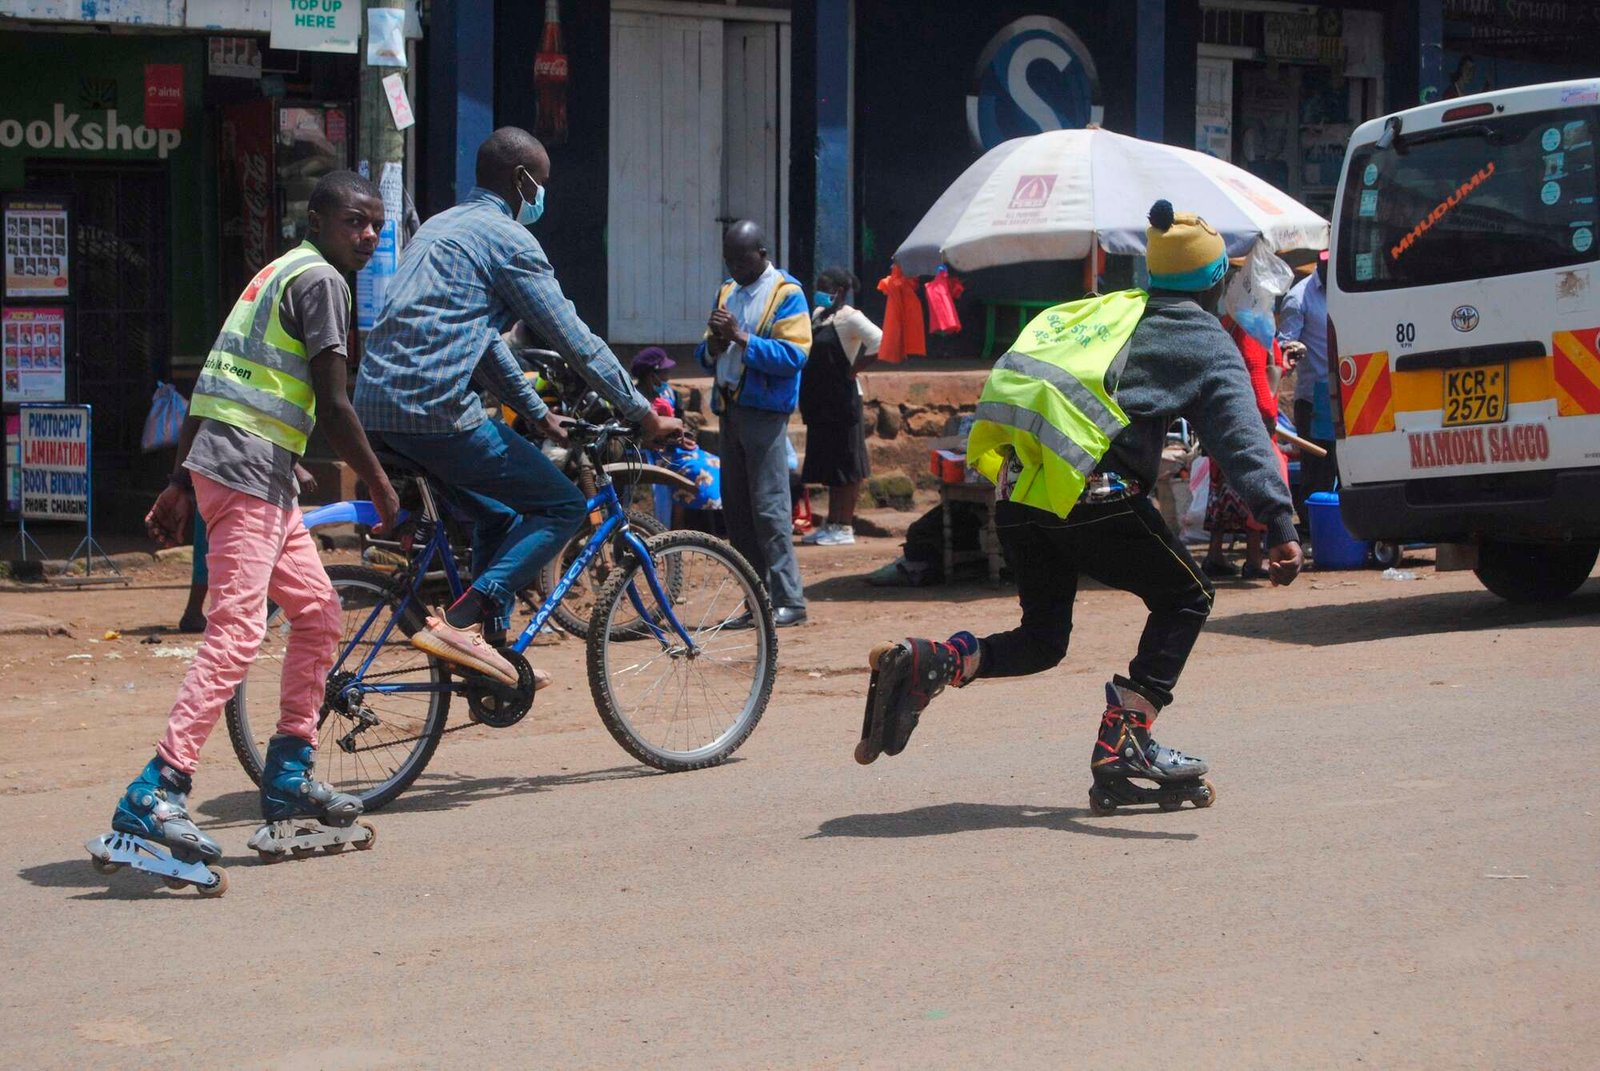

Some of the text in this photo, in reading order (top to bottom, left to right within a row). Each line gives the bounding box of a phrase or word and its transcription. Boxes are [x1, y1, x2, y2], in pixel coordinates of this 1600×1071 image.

[289, 0, 343, 13] TOP UP
[295, 14, 337, 29] HERE
[158, 86, 181, 97] airtel
[1391, 160, 1496, 260] MHUDUMU
[1396, 322, 1415, 343] 80
[1448, 370, 1487, 398] KCR
[1447, 395, 1500, 423] 257G
[28, 412, 82, 437] PHOTOCOPY
[24, 440, 86, 466] LAMINATION
[1408, 423, 1550, 470] NAMOKI SACCO
[22, 468, 88, 496] BOOK BINDING
[24, 497, 88, 515] PHONE CHARGING
[526, 550, 592, 635] RALEIGH
